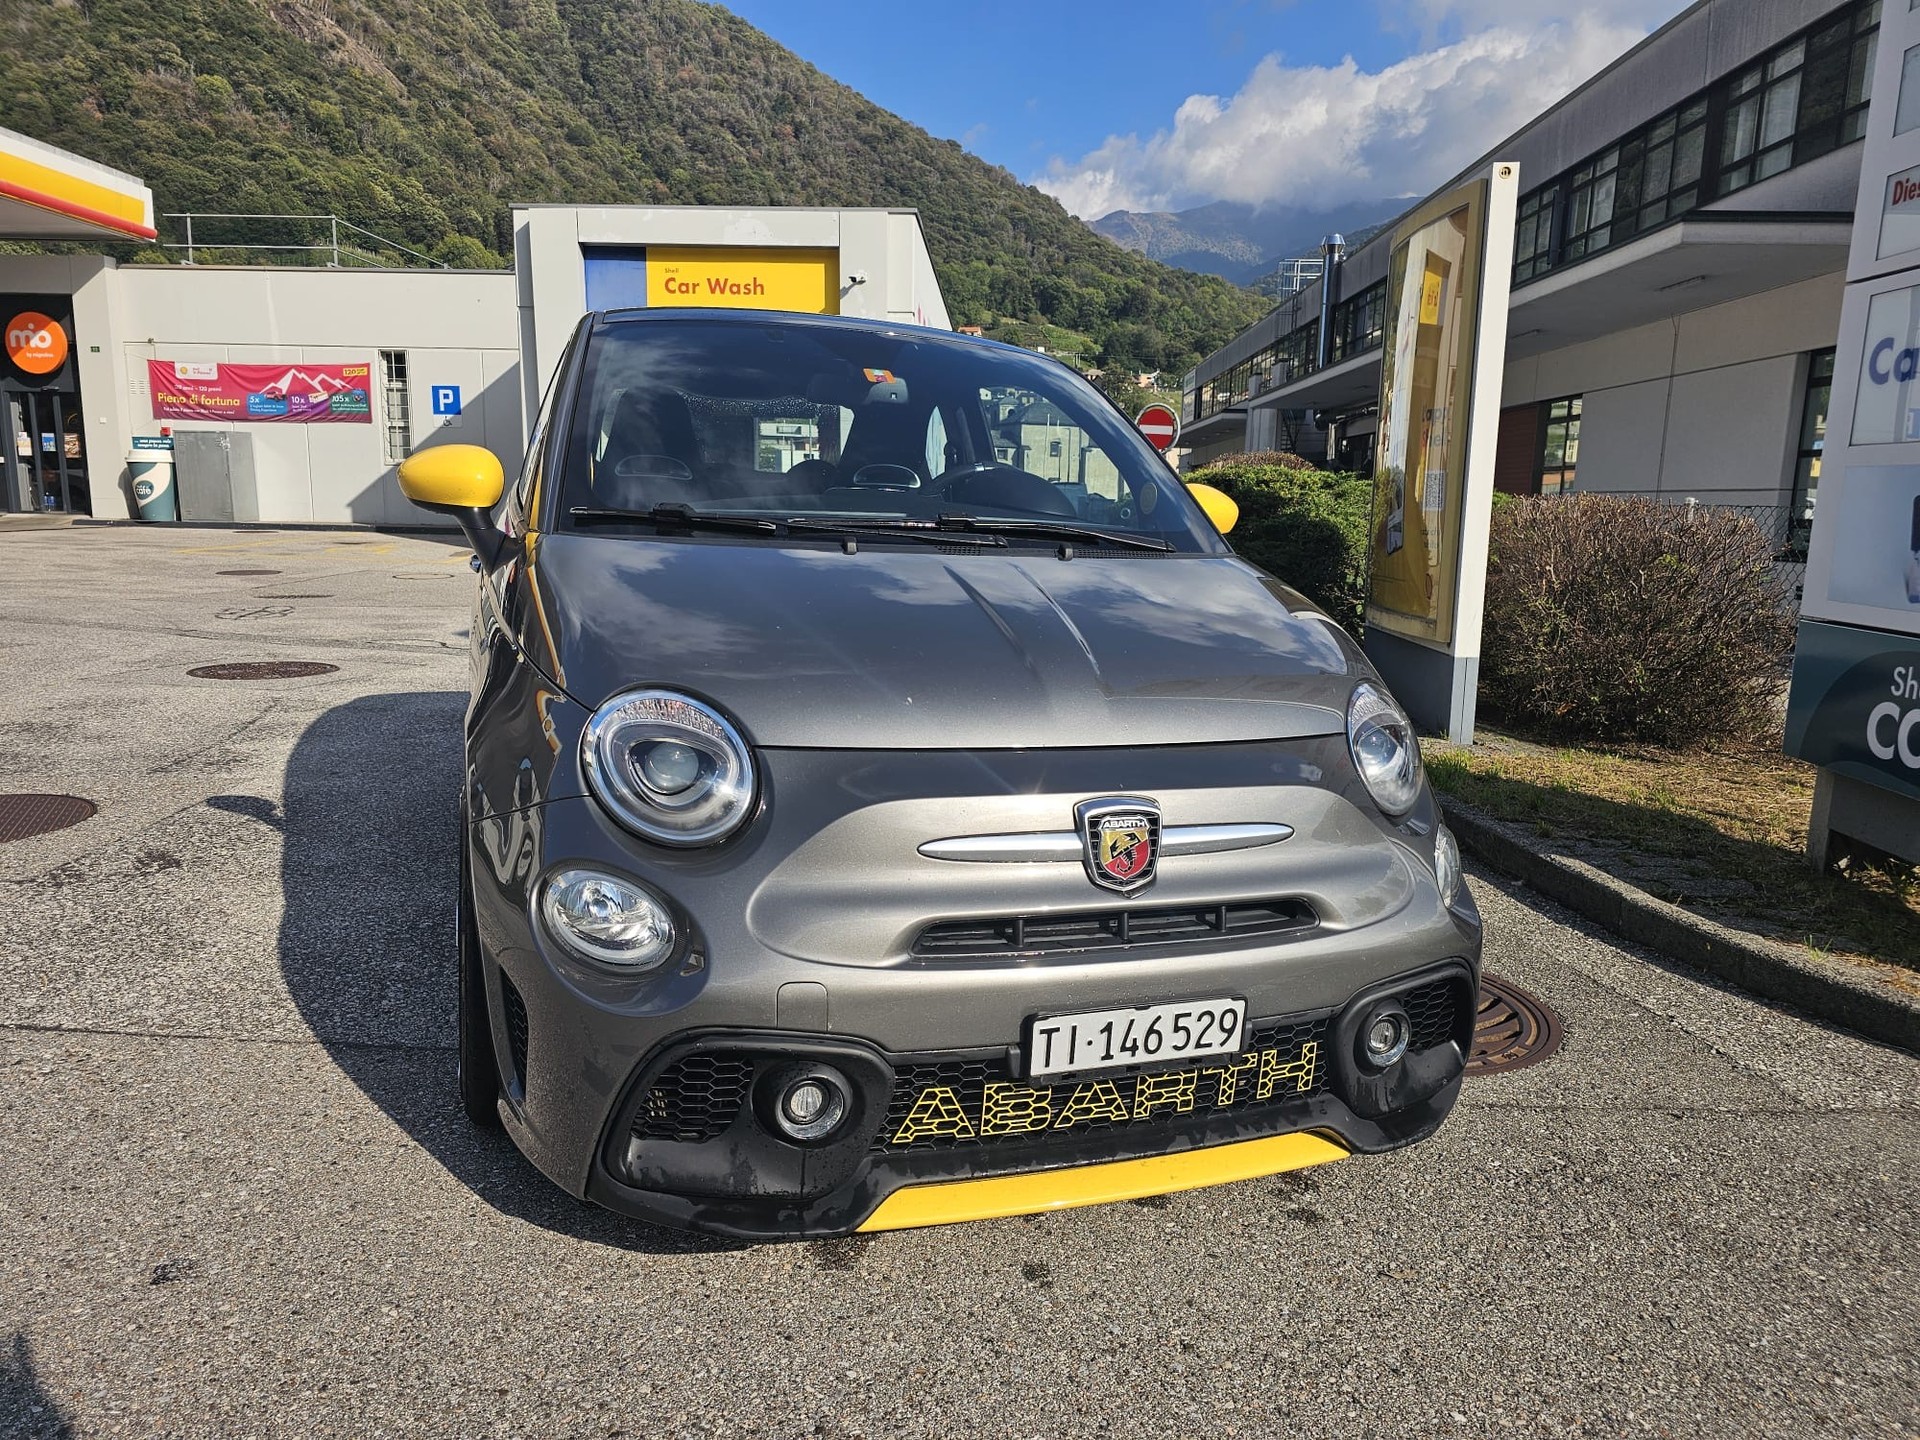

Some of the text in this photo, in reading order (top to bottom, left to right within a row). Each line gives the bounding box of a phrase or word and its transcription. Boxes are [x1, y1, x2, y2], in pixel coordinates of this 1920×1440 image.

[664, 277, 765, 296] Car Wash
[10, 323, 52, 348] mio
[157, 392, 241, 407] Pieno di fortuna
[439, 389, 454, 412] P
[1891, 666, 1920, 700] Sh
[1103, 819, 1146, 829] ABARTH
[892, 1041, 1317, 1143] ABARTH
